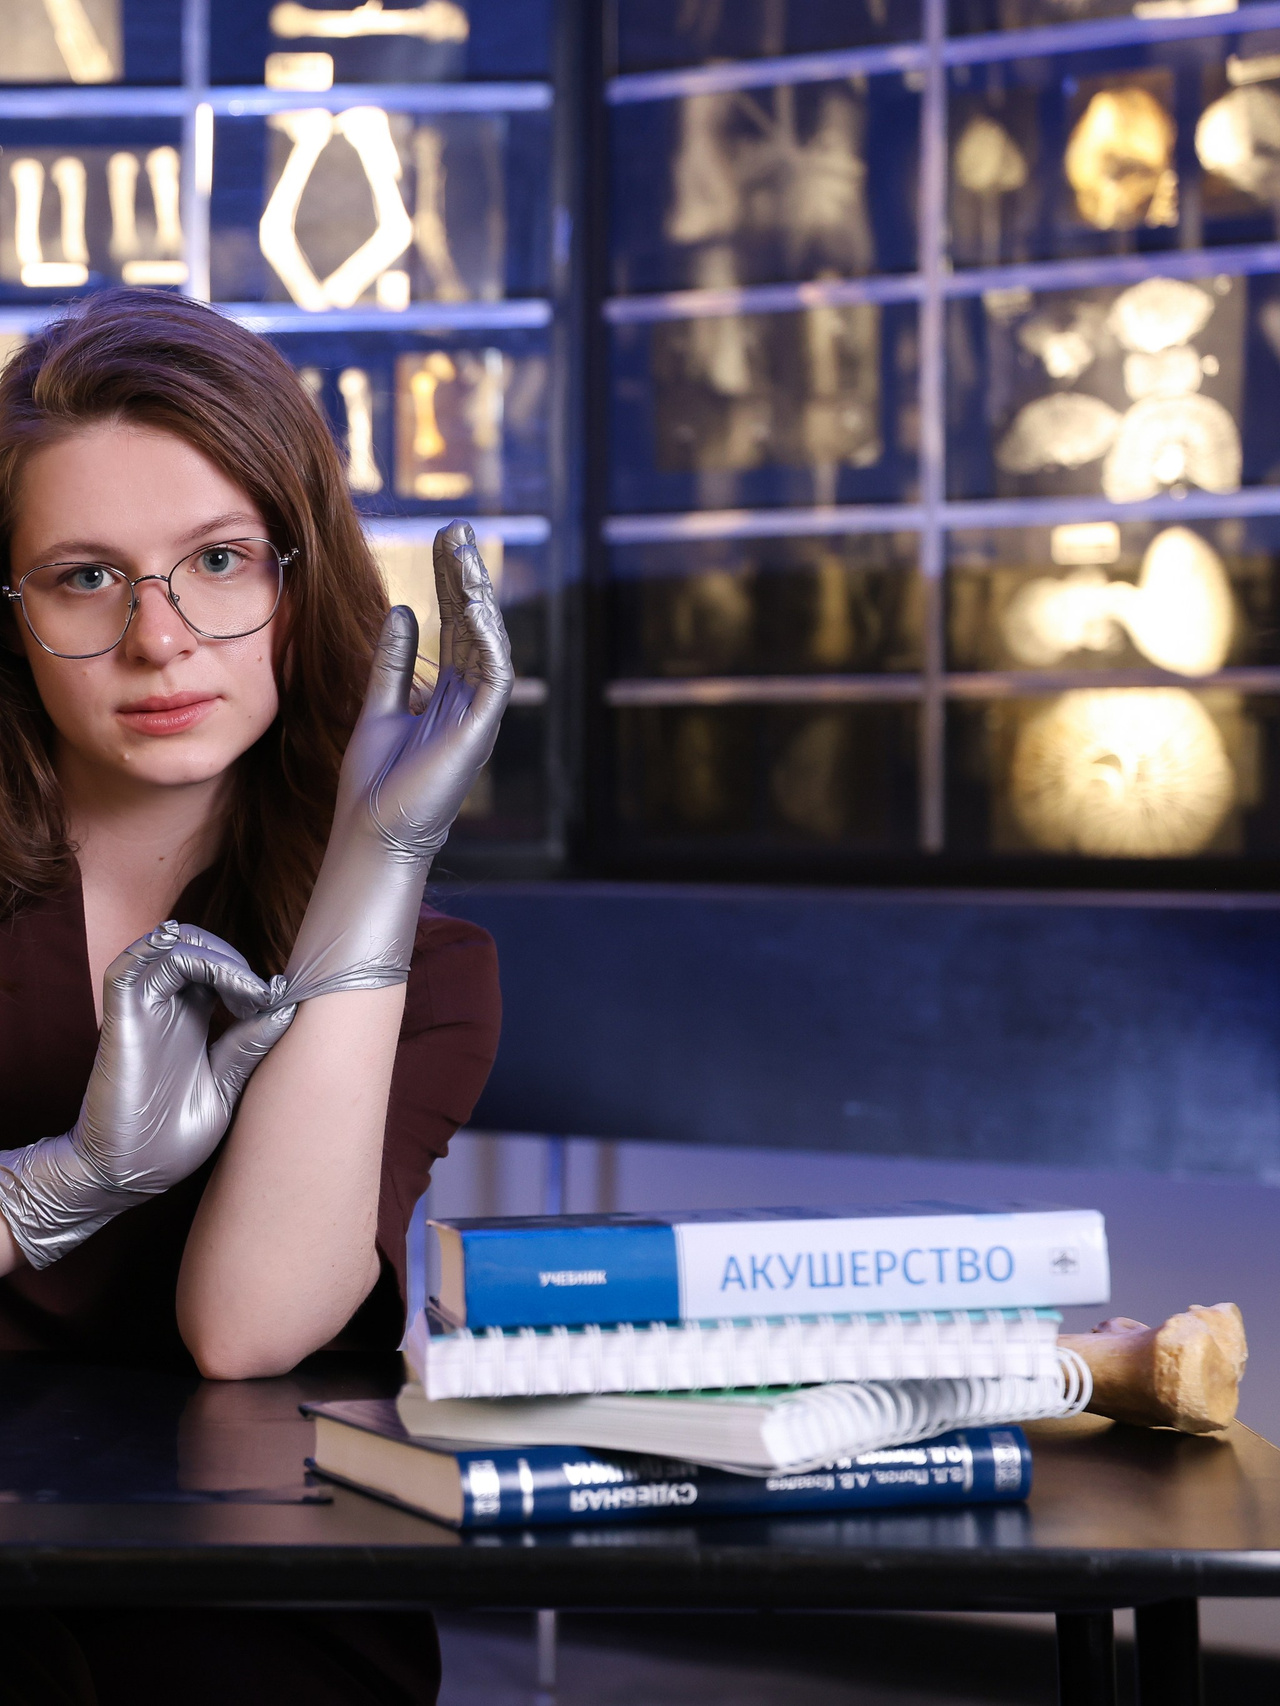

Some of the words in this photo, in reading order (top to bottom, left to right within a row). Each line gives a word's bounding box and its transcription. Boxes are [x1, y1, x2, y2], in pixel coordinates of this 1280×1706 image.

[538, 1269, 608, 1288] УЧЕБНИК
[720, 1245, 1014, 1291] АКУШЕРСТВО
[836, 1472, 870, 1489] А.В.
[570, 1482, 698, 1512] СУДЕБНАЯ
